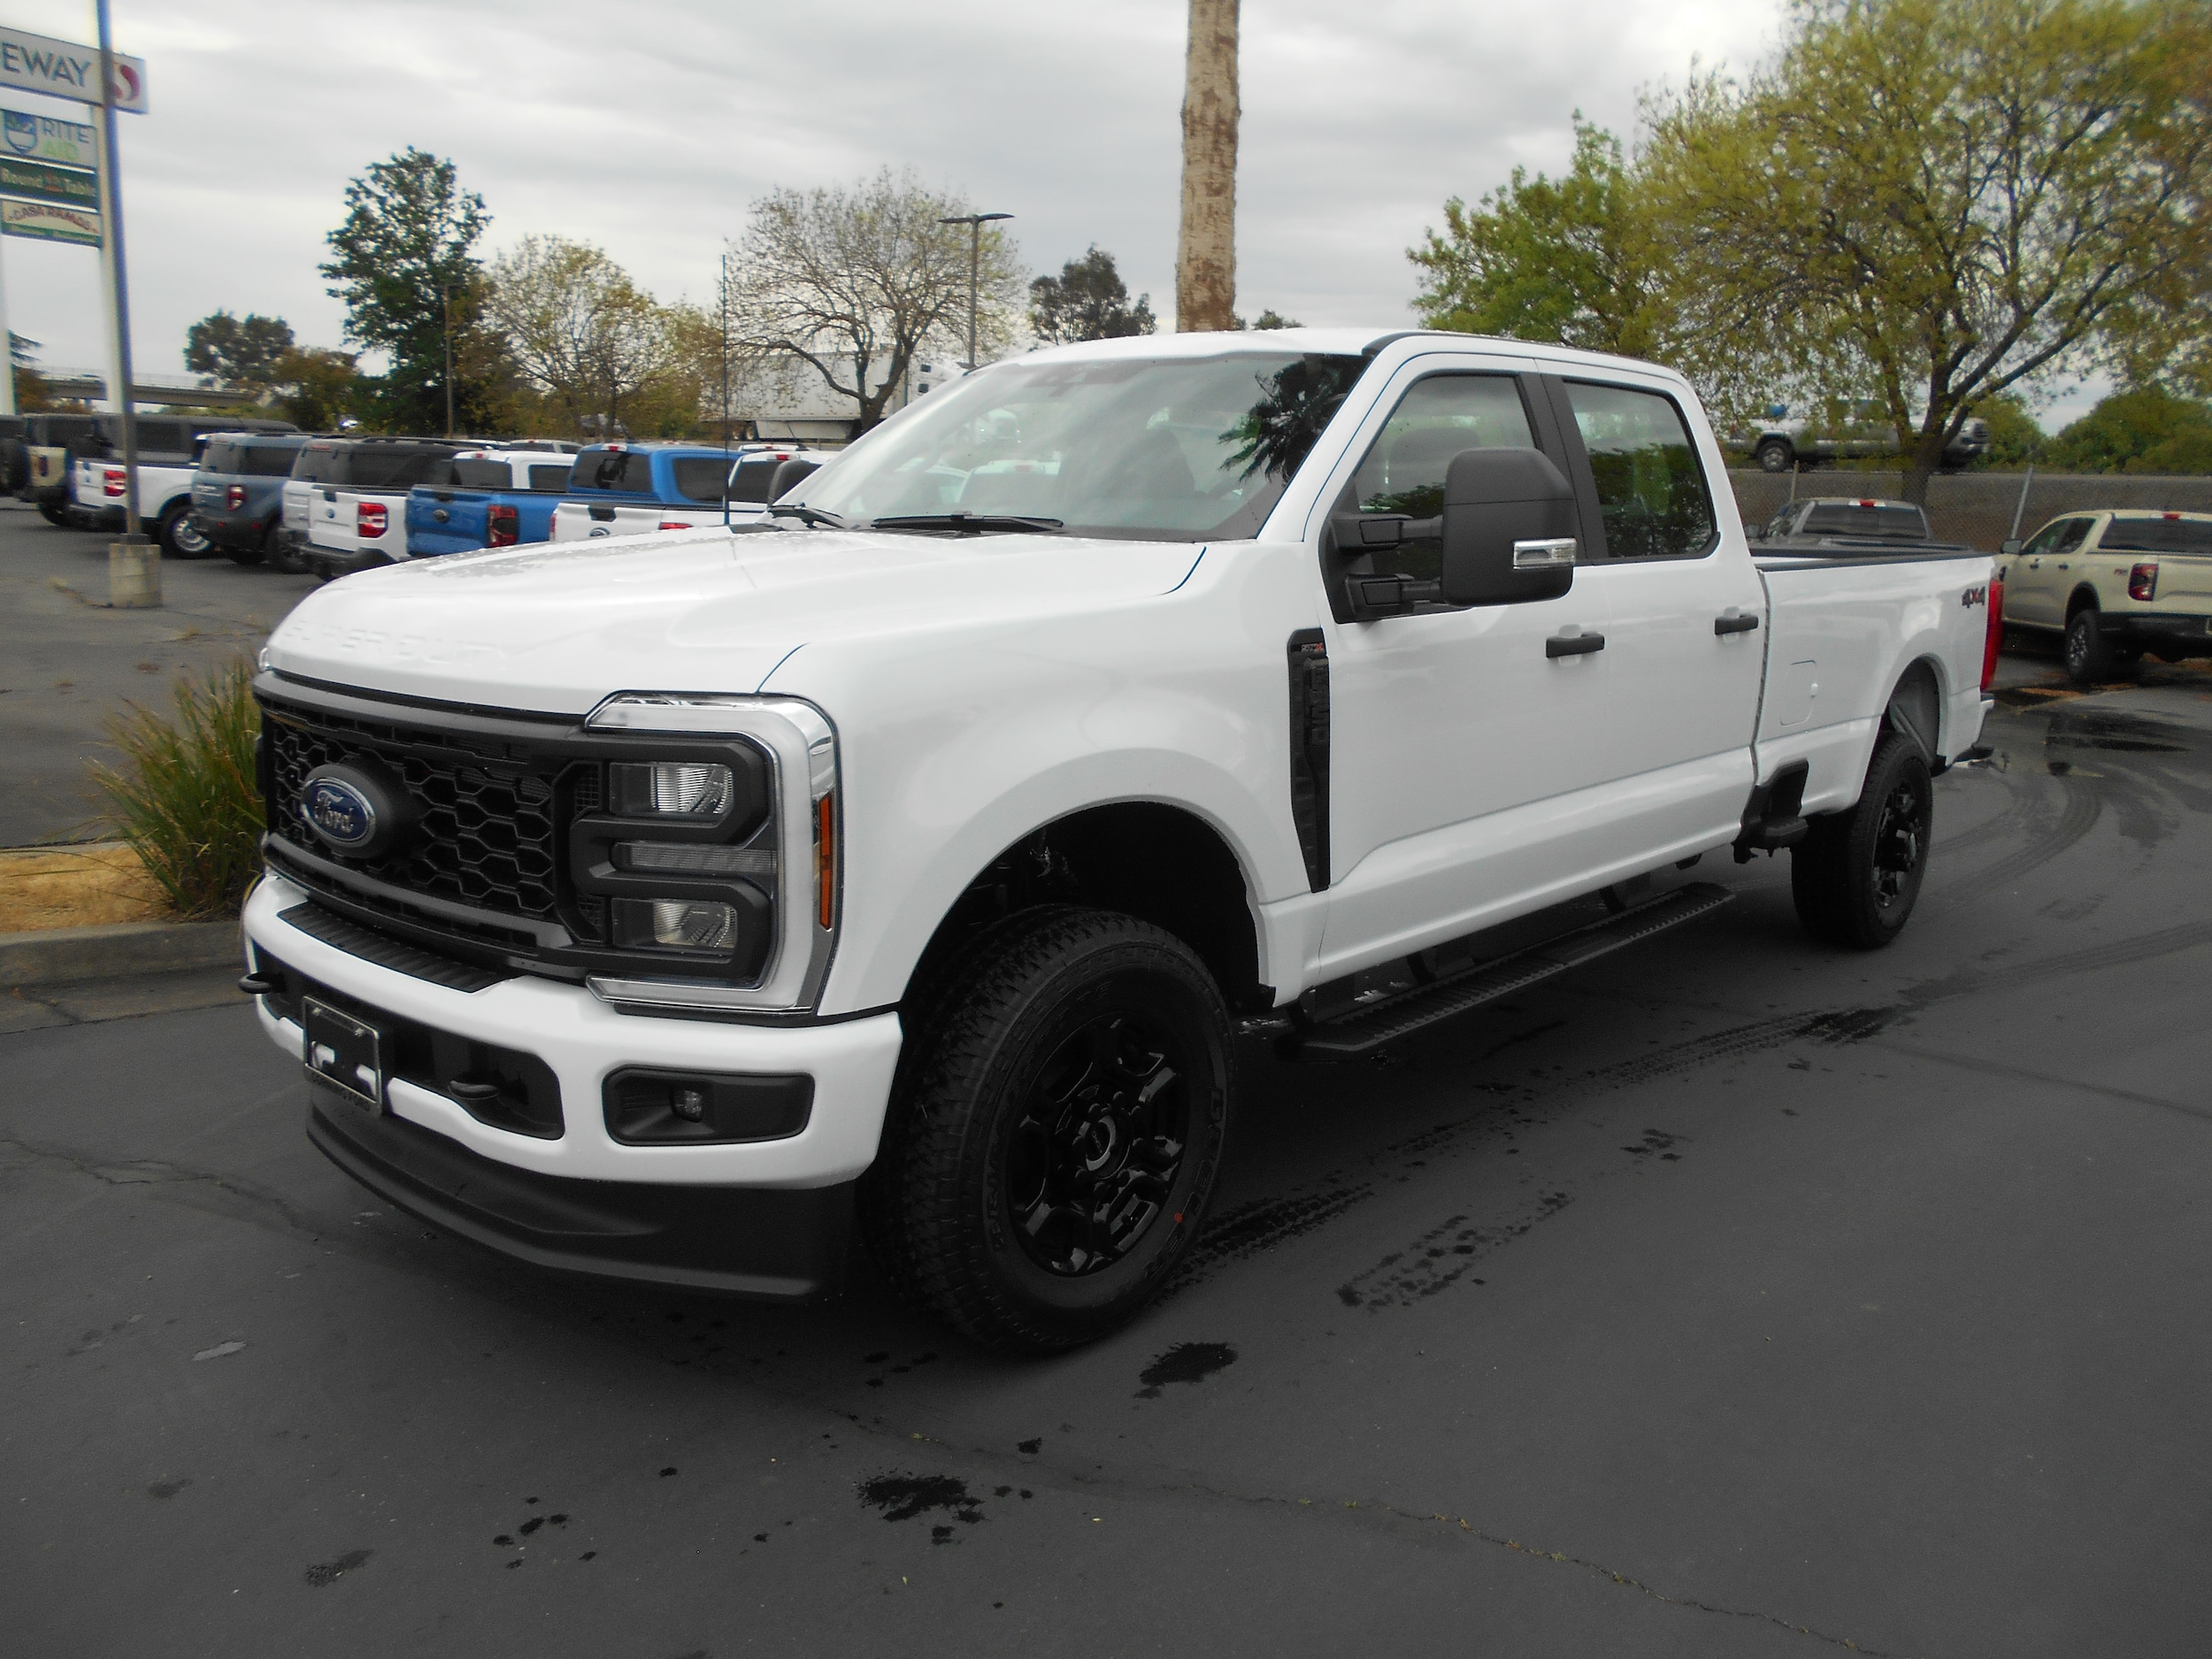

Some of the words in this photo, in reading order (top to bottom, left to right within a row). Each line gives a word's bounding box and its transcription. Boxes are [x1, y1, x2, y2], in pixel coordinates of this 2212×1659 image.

[4, 43, 90, 87] EWAY
[42, 118, 89, 143] RITE
[313, 789, 355, 833] Ford
